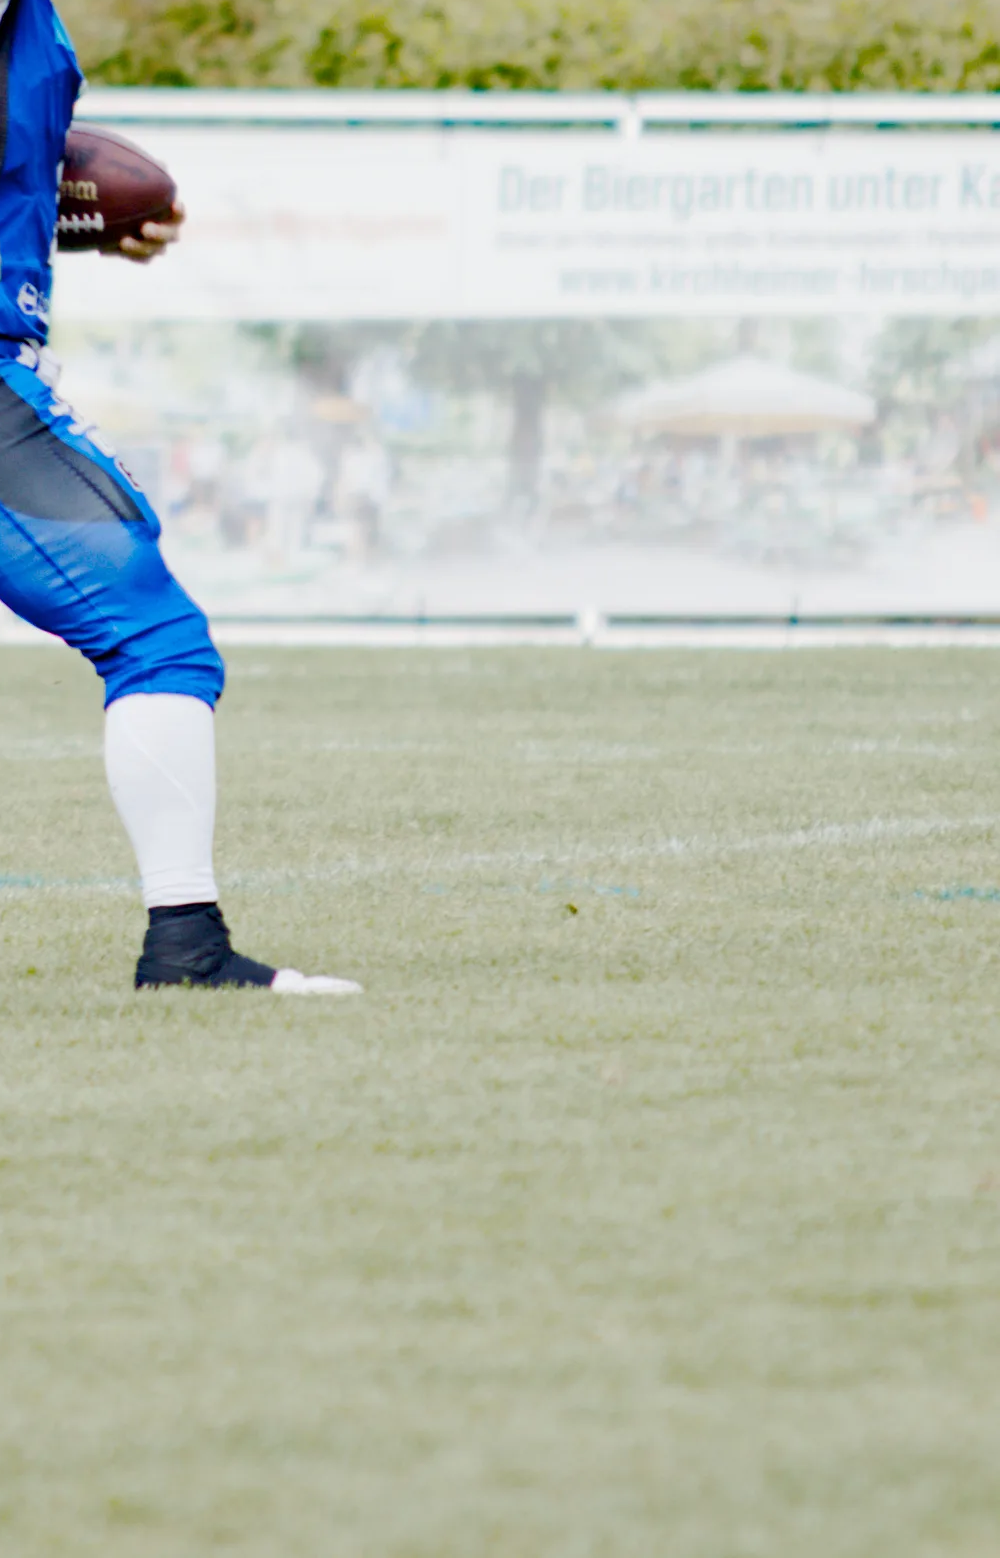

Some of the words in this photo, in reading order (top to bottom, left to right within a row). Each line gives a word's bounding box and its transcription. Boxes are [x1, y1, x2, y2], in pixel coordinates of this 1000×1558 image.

[498, 166, 568, 213] Der
[580, 165, 815, 223] Biergarten
[827, 165, 943, 213] unter
